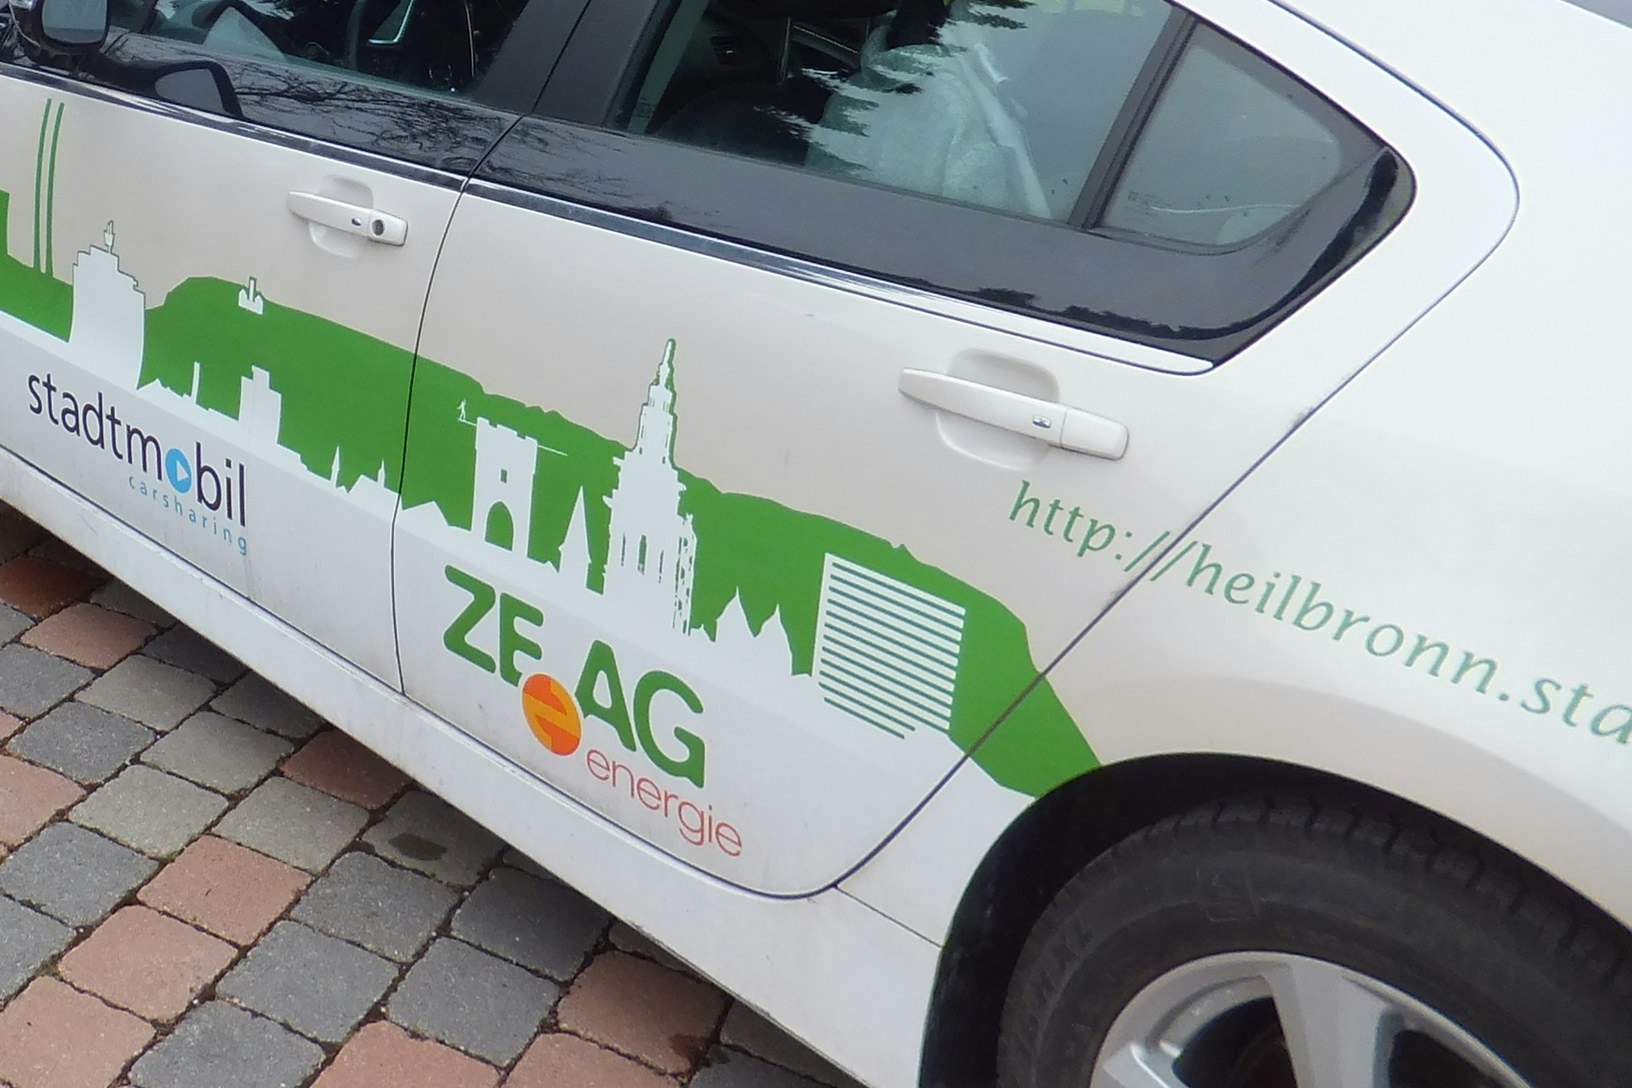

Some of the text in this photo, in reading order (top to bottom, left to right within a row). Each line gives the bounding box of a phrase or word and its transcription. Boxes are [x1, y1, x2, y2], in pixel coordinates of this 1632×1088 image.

[27, 373, 246, 528] stadtmobil
[128, 474, 248, 556] carsharing
[586, 748, 743, 857] energie
